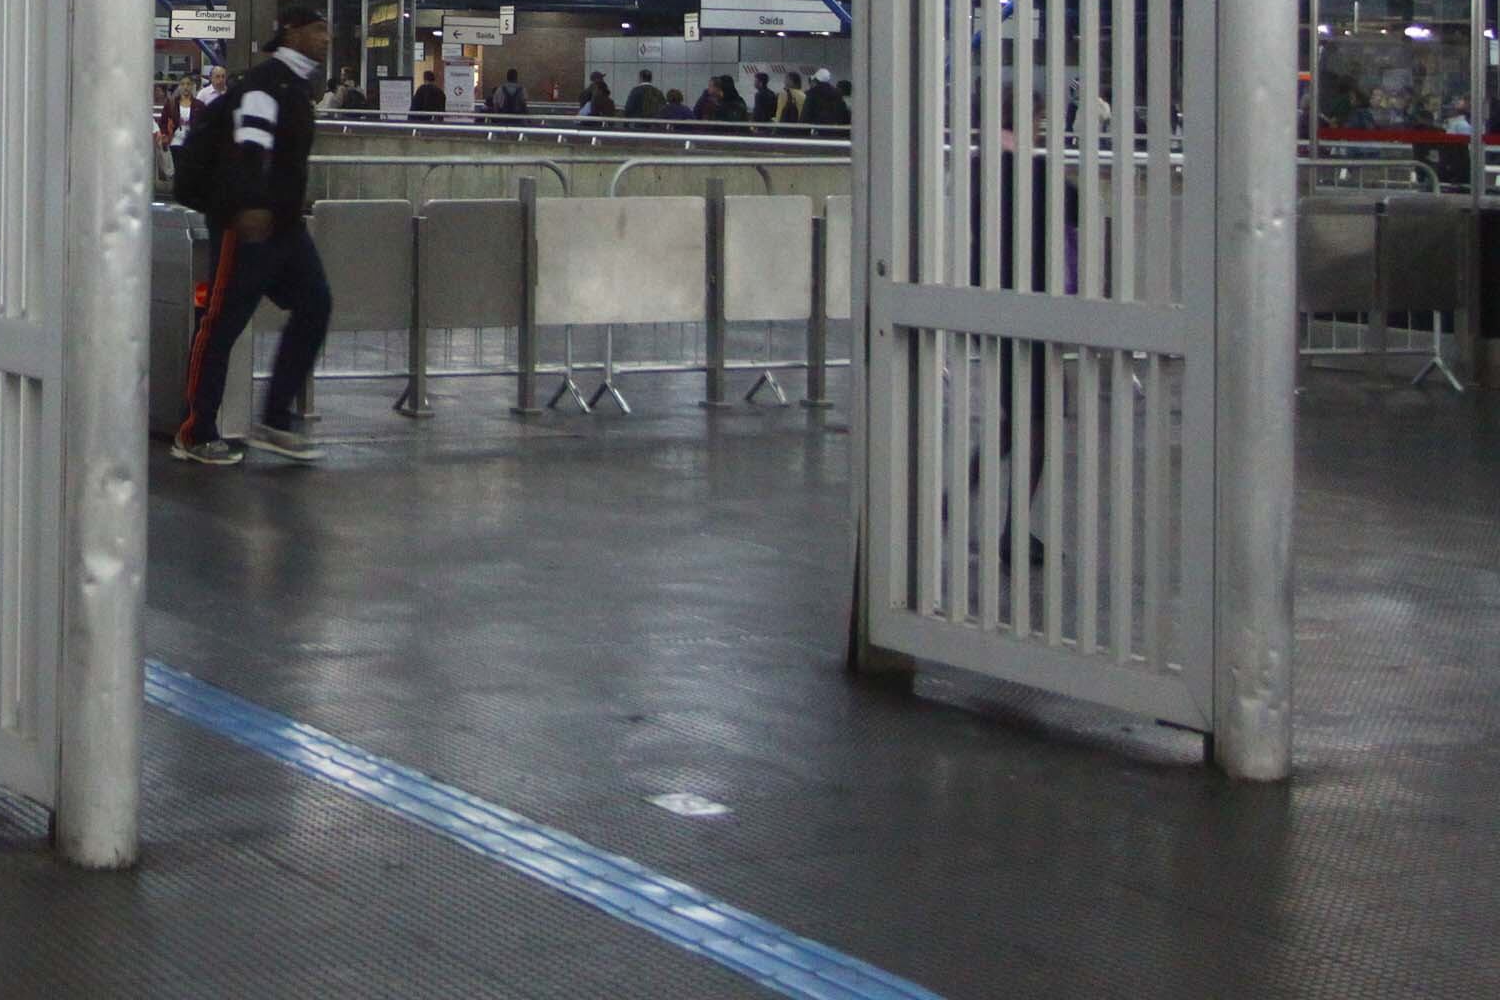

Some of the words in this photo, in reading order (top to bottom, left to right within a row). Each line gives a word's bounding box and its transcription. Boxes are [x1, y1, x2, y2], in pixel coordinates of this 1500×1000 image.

[195, 10, 232, 19] Embarque
[504, 19, 510, 31] 5
[758, 16, 784, 26] Saída
[207, 25, 231, 33] Itapevi
